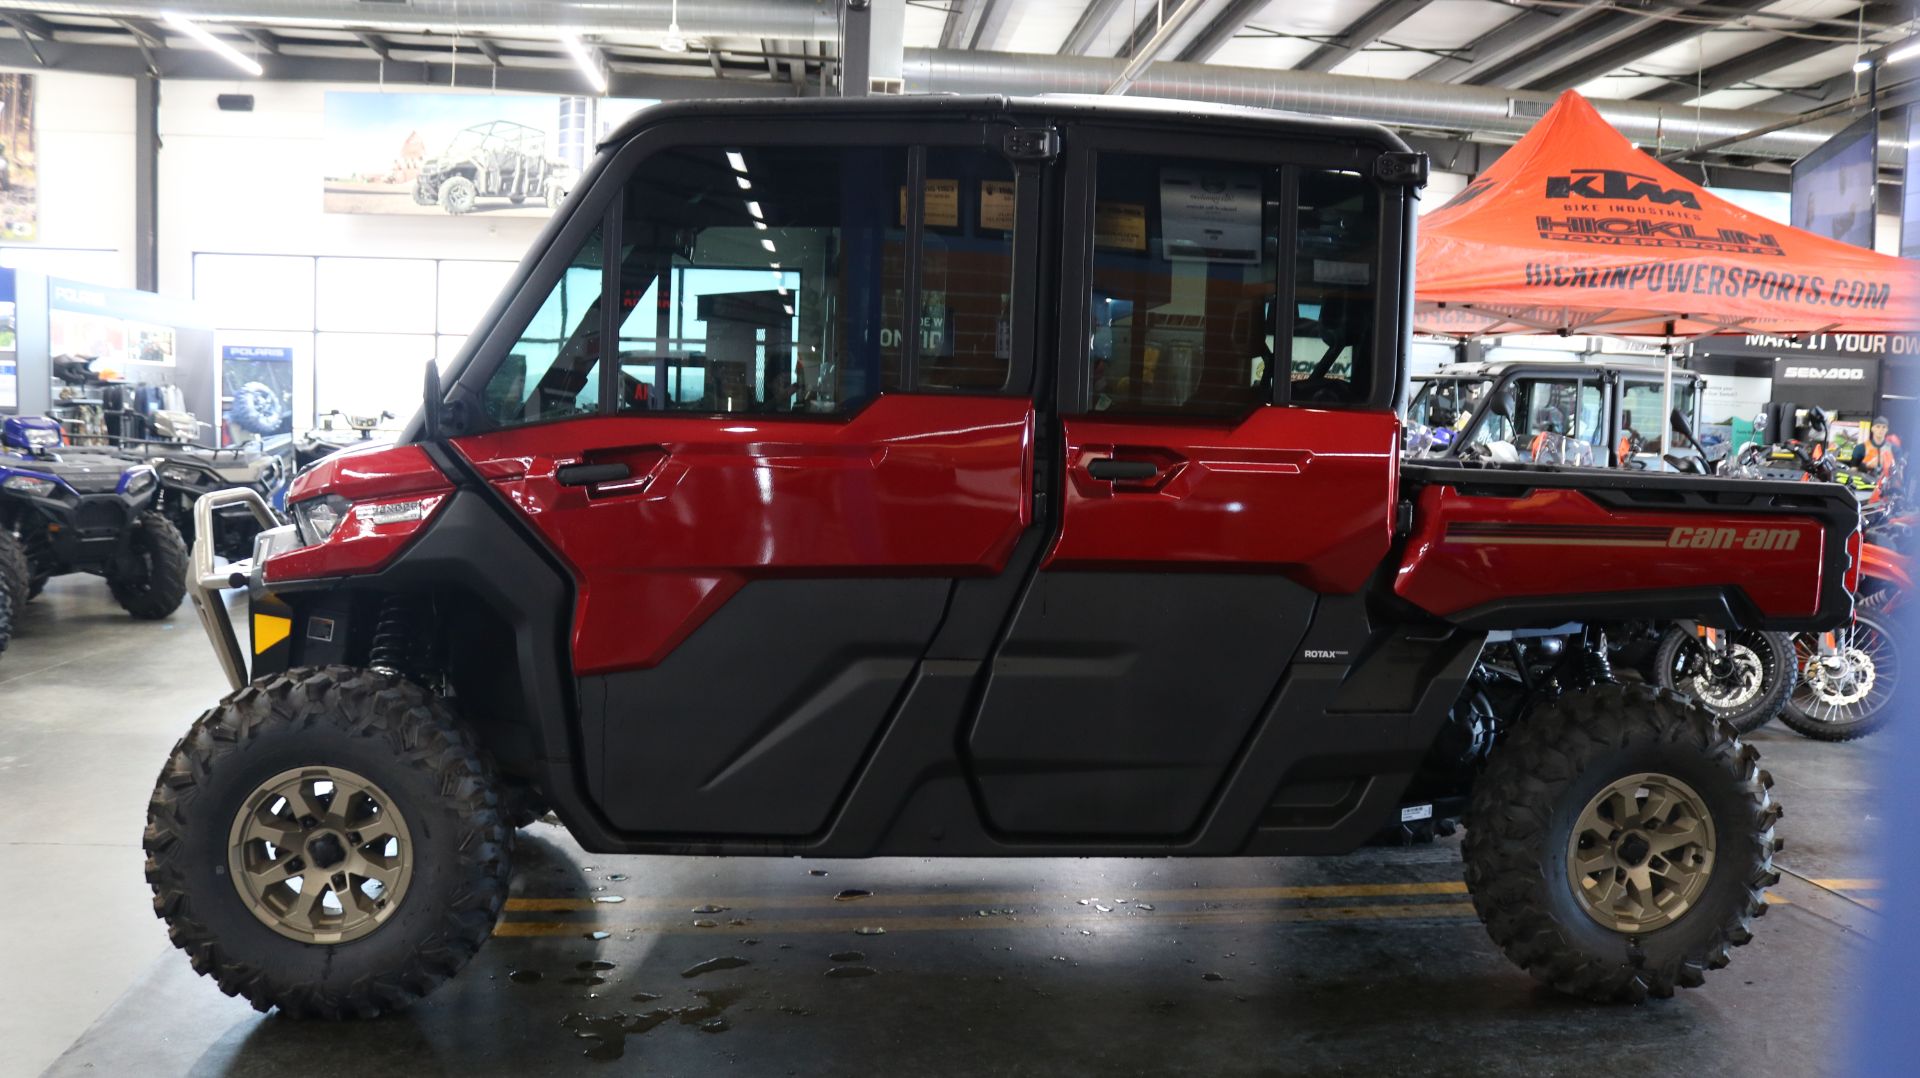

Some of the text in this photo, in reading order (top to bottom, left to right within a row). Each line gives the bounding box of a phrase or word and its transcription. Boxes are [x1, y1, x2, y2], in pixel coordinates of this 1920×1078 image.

[1546, 169, 1702, 210] KTM
[1563, 204, 1702, 221] BIKE INDUSTRIES
[1536, 216, 1780, 248] HICKLIN
[1542, 233, 1785, 256] POWERSPORTS
[1525, 261, 1891, 310] HICKLINPOWERSPORTS.COM
[230, 348, 284, 357] POLARIS
[1834, 334, 1887, 353] YOUR
[1668, 527, 1800, 550] can-am
[1304, 650, 1335, 658] ROTAX
